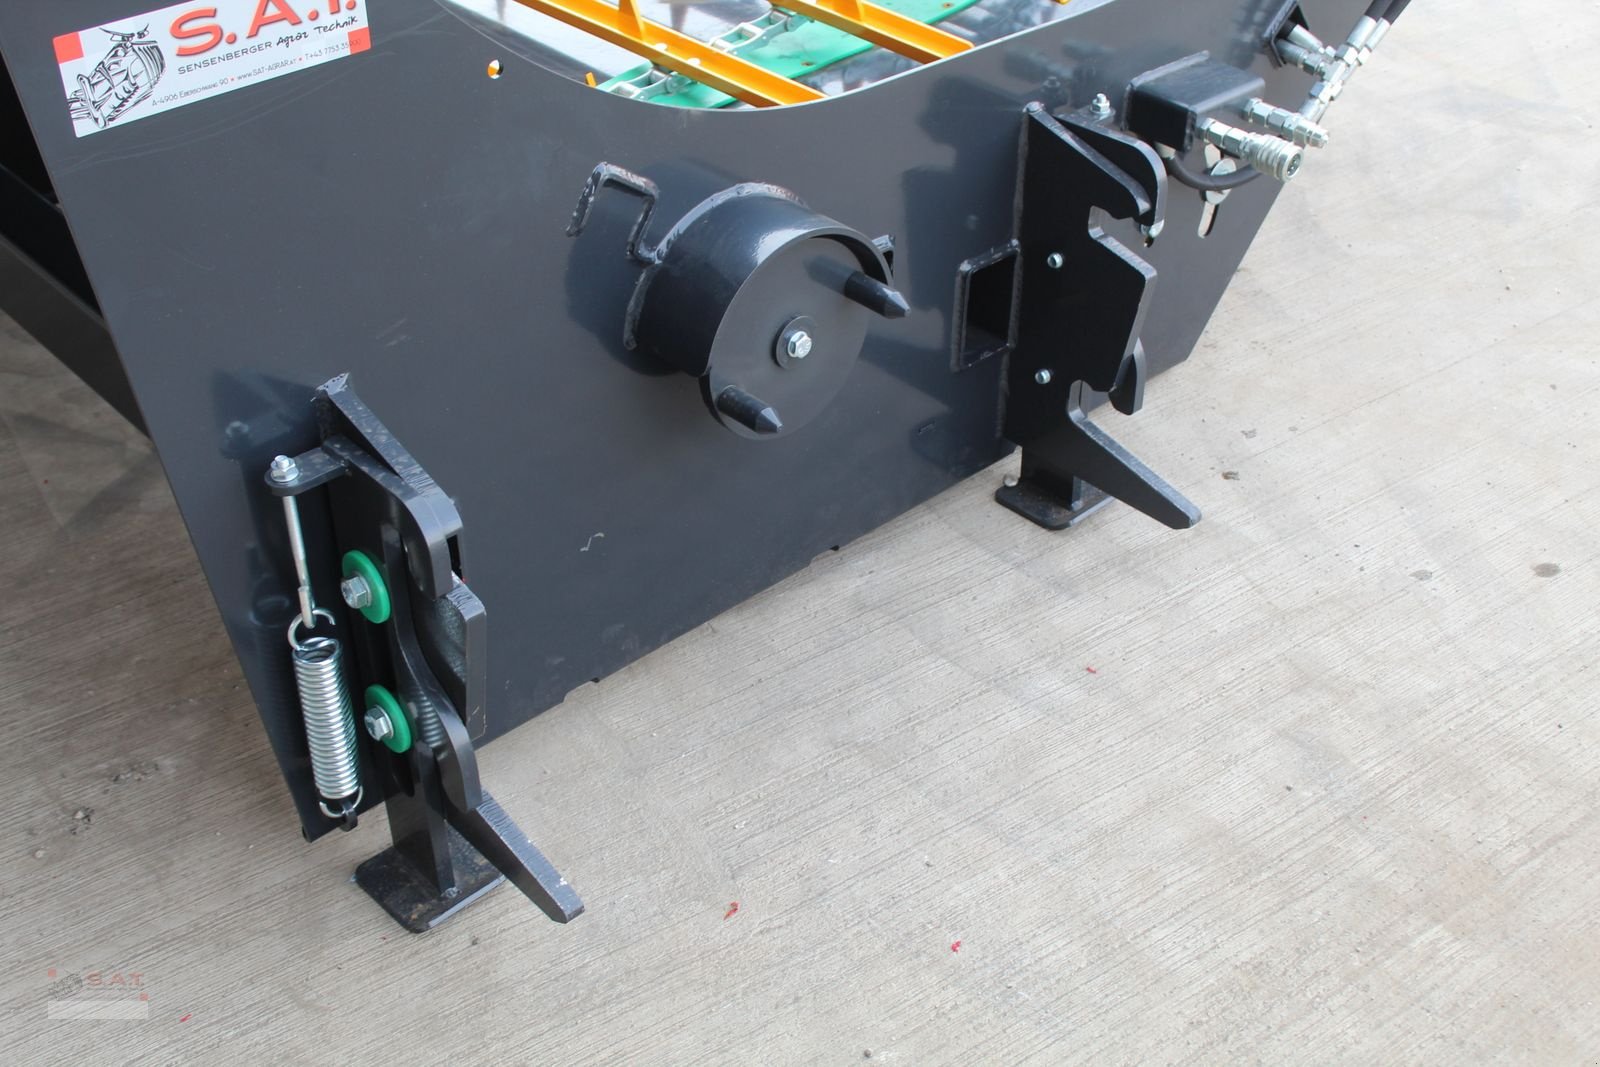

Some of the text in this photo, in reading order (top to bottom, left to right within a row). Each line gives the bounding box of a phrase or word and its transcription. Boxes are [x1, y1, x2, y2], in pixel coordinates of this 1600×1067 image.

[178, 16, 358, 75] SENSENBERGER Agrar Technik
[152, 94, 178, 107] A-4906
[219, 77, 229, 86] 90
[324, 45, 339, 56] 7753
